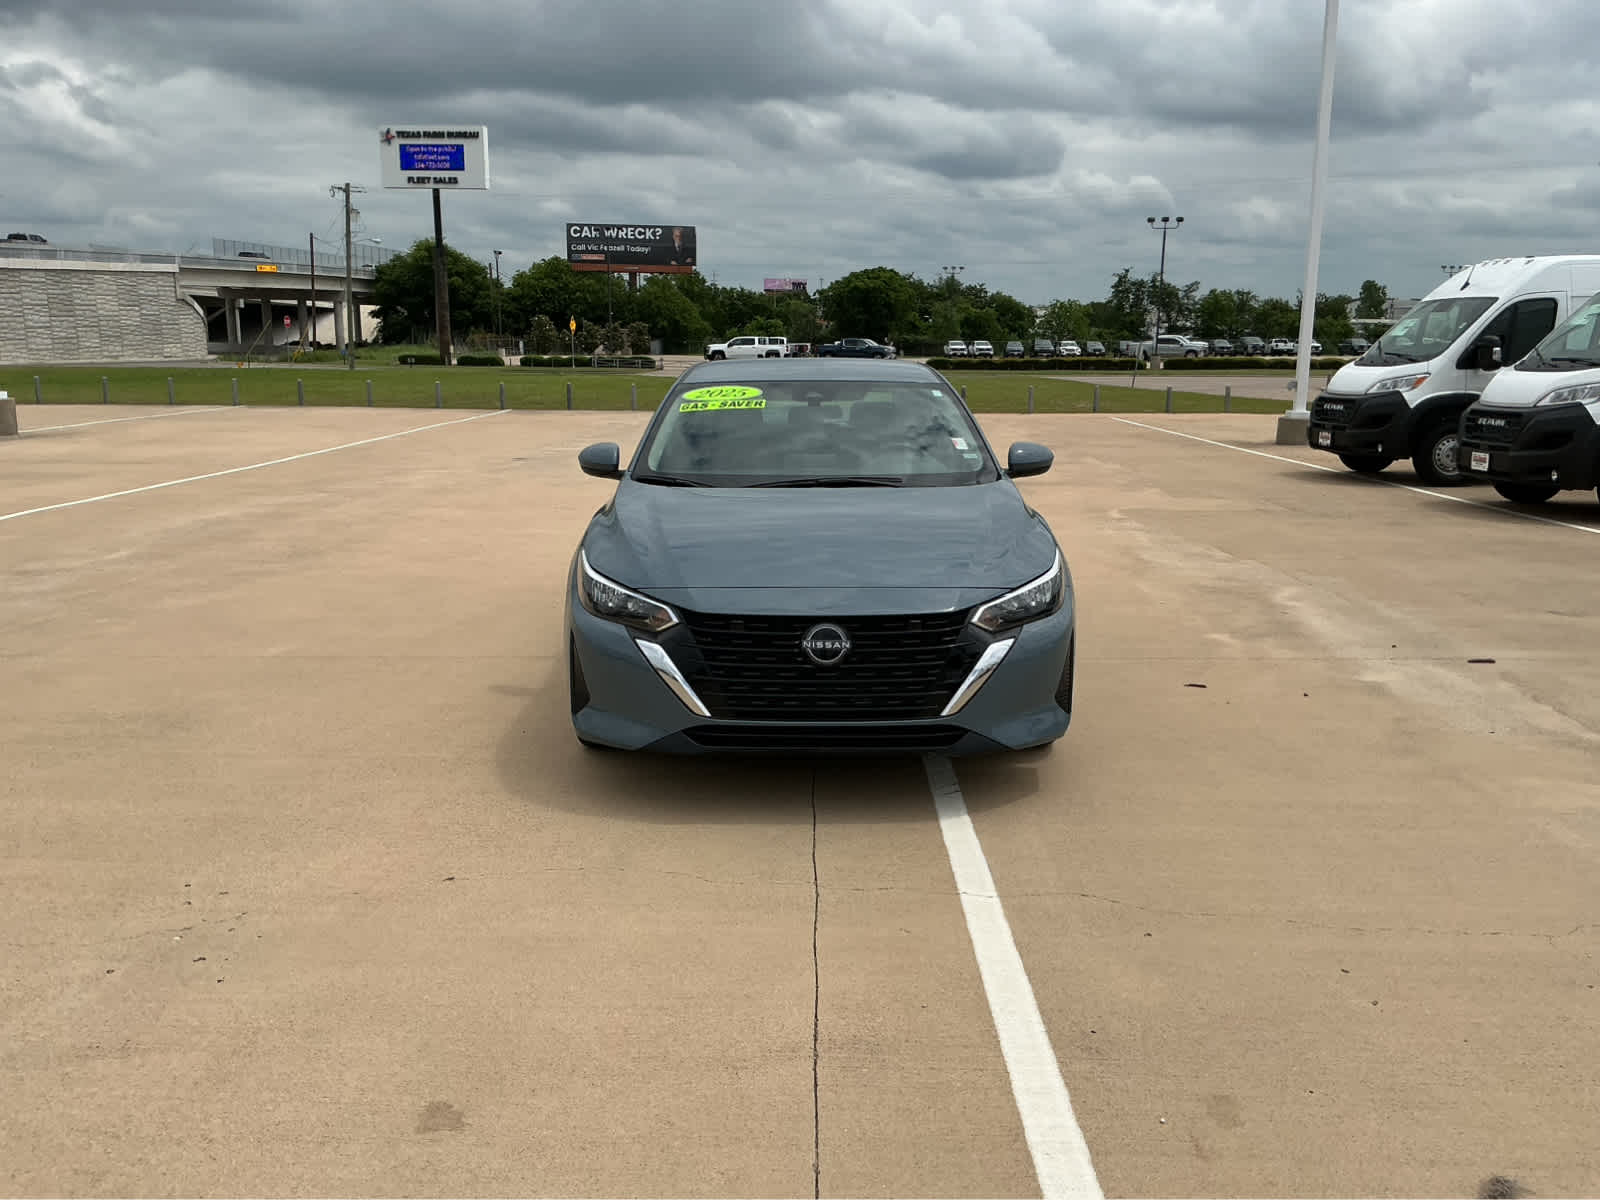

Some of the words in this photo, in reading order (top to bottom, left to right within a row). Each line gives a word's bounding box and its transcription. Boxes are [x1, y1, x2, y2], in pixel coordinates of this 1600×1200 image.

[395, 131, 421, 139] TEXAS
[423, 131, 445, 139] FARM
[447, 131, 479, 139] BUREAU
[407, 176, 431, 184] FLEET
[432, 176, 458, 184] SALES
[603, 226, 663, 240] WRECK?
[681, 402, 709, 411] GAS
[719, 399, 764, 409] SAVER
[803, 640, 850, 649] NISSAN
